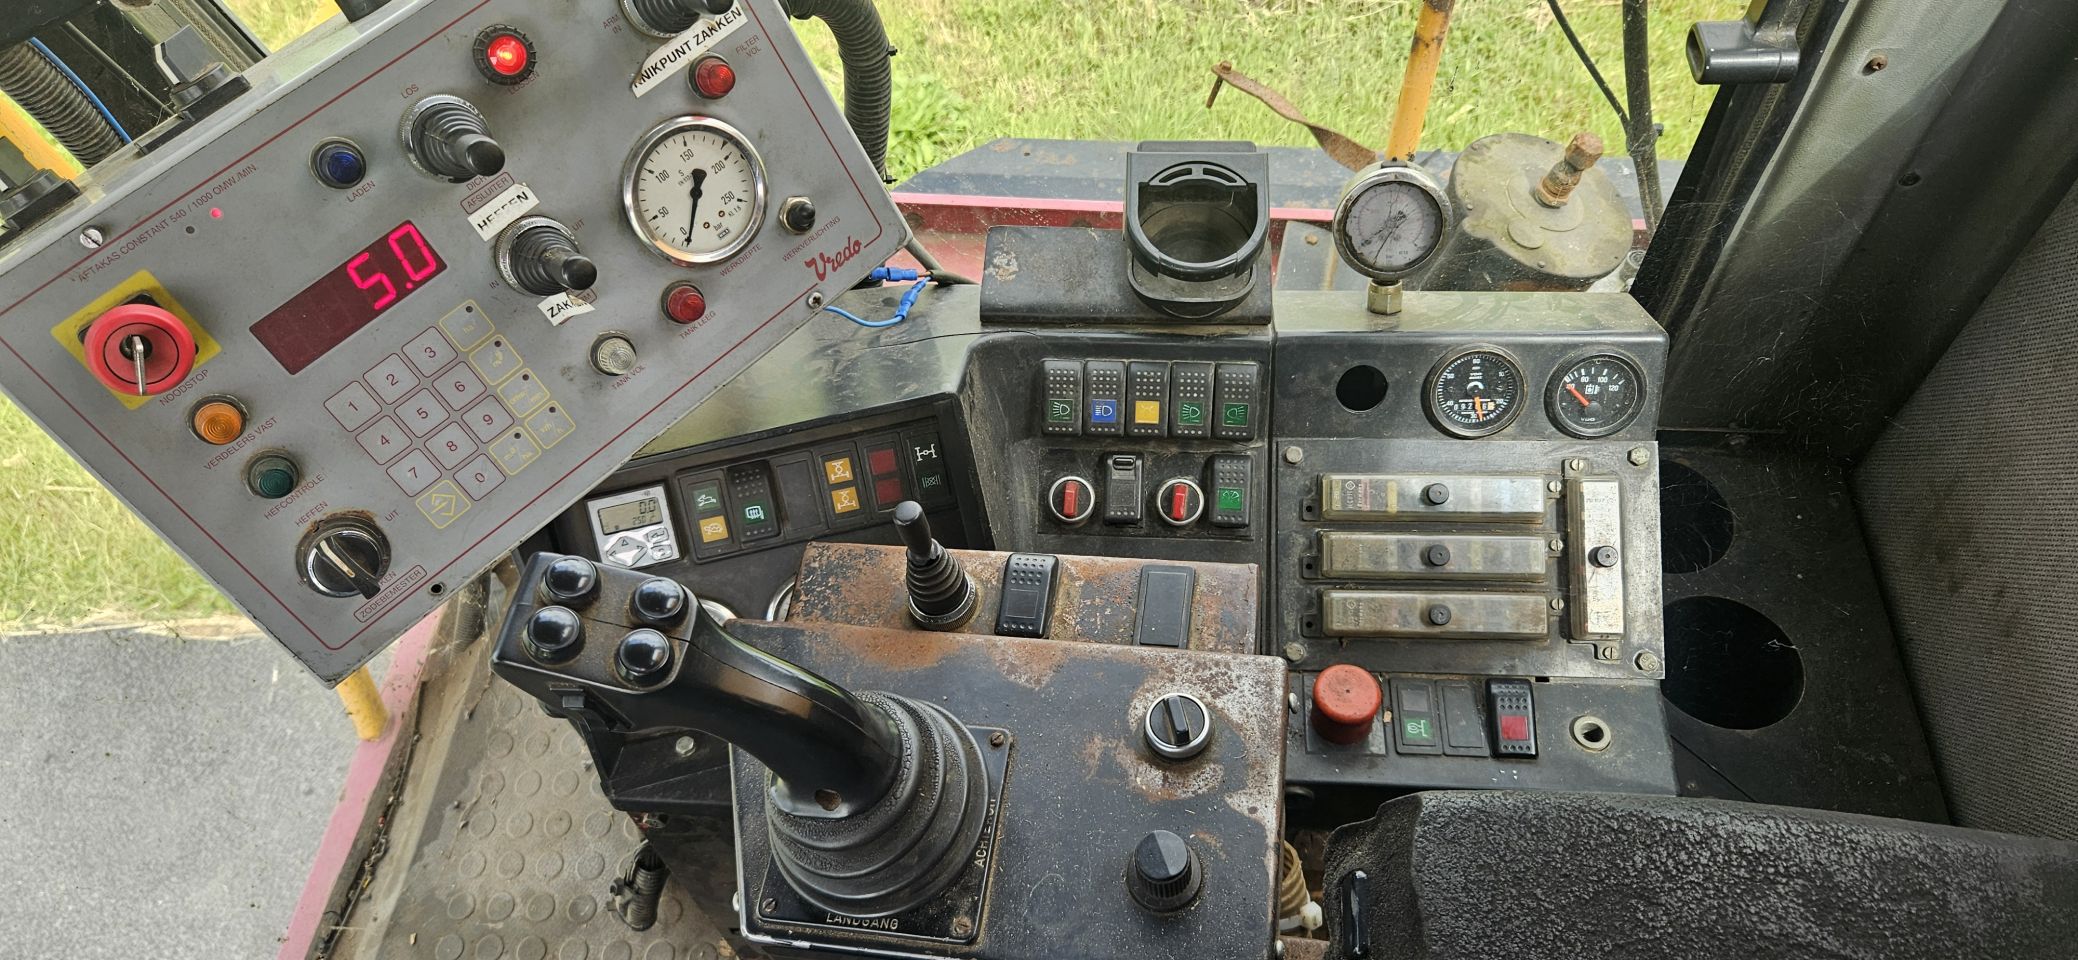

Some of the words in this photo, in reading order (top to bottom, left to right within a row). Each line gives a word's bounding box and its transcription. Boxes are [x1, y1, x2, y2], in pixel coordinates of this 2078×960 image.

[603, 14, 621, 29] ARM
[694, 6, 742, 46] ZAKKEN
[613, 25, 623, 35] IN
[735, 35, 760, 54] FILTER
[747, 45, 762, 58] VOL
[401, 84, 419, 99] LOS
[680, 148, 694, 163] 150
[711, 160, 725, 175] 200
[466, 175, 488, 191] DICH
[655, 169, 670, 184] 100
[346, 180, 376, 203] LADEN
[466, 176, 510, 208] AFSLUITER
[721, 190, 735, 206] 250
[658, 206, 669, 218] 50
[572, 218, 585, 232] UIT
[680, 226, 687, 236] 0
[713, 222, 723, 232] bar
[78, 253, 121, 283] AFTAKAS
[120, 219, 169, 255] CONSTANT
[170, 208, 187, 223] 540
[192, 192, 213, 209] 1000
[782, 215, 841, 262] WERKVERLICHTING
[719, 243, 762, 277] WERKDIEPTE
[804, 235, 862, 282] Vredo
[347, 223, 437, 311] 5.0
[489, 277, 501, 290] IN
[679, 323, 699, 341] TANK
[696, 310, 716, 327] LEEG
[424, 346, 437, 359] 3
[386, 373, 399, 386] 2
[611, 374, 631, 391] TANK
[630, 363, 646, 378] VOL
[1597, 375, 1608, 384] 100
[159, 369, 209, 407] NOODSTOP
[454, 380, 466, 393] 6
[348, 401, 358, 413] 1
[417, 407, 429, 420] 5
[483, 413, 494, 426] 9
[203, 433, 256, 471] VERDELERS
[255, 416, 278, 436] VAST
[379, 434, 391, 447] 4
[446, 440, 458, 452] 8
[408, 467, 419, 480] 7
[475, 471, 486, 484] 0
[264, 473, 325, 521] HEFCONTROLE
[295, 500, 329, 527] HEFFEN
[637, 500, 656, 515] 0.0
[384, 509, 400, 522] UIT
[379, 571, 397, 586] KEN
[360, 569, 422, 619] ZODEBEMESTER
[826, 912, 899, 930] LANDGANG
